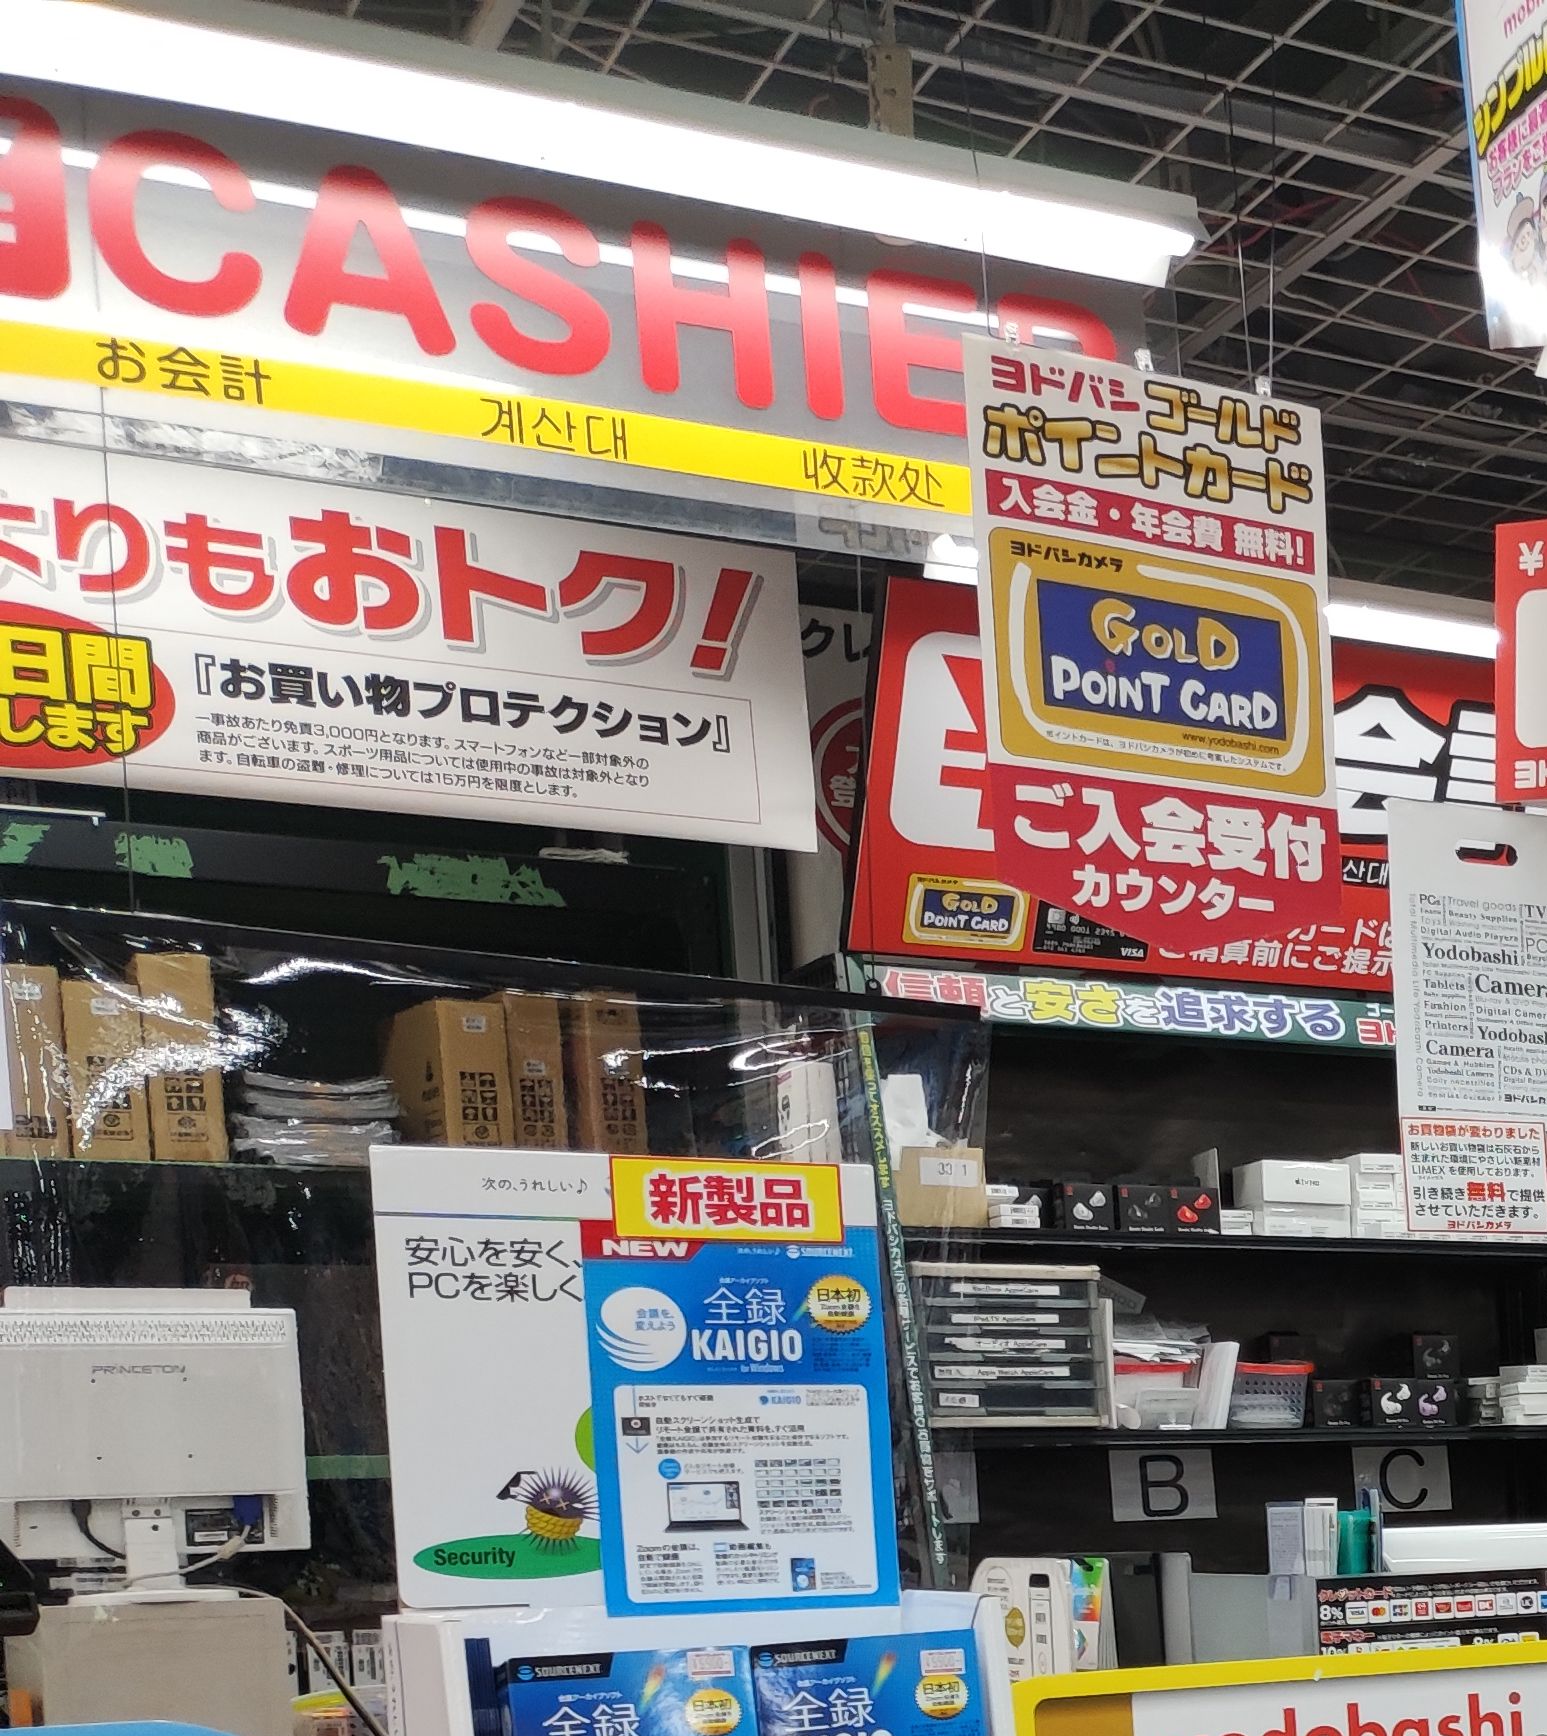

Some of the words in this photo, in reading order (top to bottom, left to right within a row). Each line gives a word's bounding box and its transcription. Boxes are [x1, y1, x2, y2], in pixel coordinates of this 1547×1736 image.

[96, 337, 271, 405] お会計
[990, 356, 1141, 411] ヨドバシ
[481, 398, 627, 462] 계산대
[802, 448, 945, 507] 收款处
[983, 405, 1312, 513] ポイントカード
[1010, 540, 1124, 573] ヨドバシカメラ
[1090, 598, 1239, 672] GOLD
[194, 653, 732, 755] 『お買い物プロテクション』
[1051, 655, 1169, 711] POINT
[1180, 682, 1278, 731] CARD
[1182, 730, 1280, 756] www.yodobashi.com
[1011, 783, 1326, 882] ご入会受付
[1072, 863, 1274, 917] カウンター
[1422, 942, 1519, 967] Yodobashi
[1426, 1039, 1495, 1059] Camera
[650, 1172, 811, 1229] 新製品
[1412, 1181, 1545, 1203] 引き続き無料で提供
[1415, 1202, 1540, 1220] させていただきます。
[1447, 1219, 1513, 1231] ヨドバシカメラ
[405, 1237, 580, 1270] 安心を安く、
[602, 1238, 689, 1258] NEW
[407, 1271, 582, 1303] PCを楽しく
[702, 1287, 787, 1328] 全録
[816, 1287, 861, 1303] 日本初
[691, 1328, 803, 1363] KAIGIO
[1139, 1454, 1189, 1518] B
[1380, 1448, 1430, 1509] C
[433, 1545, 517, 1569] Security
